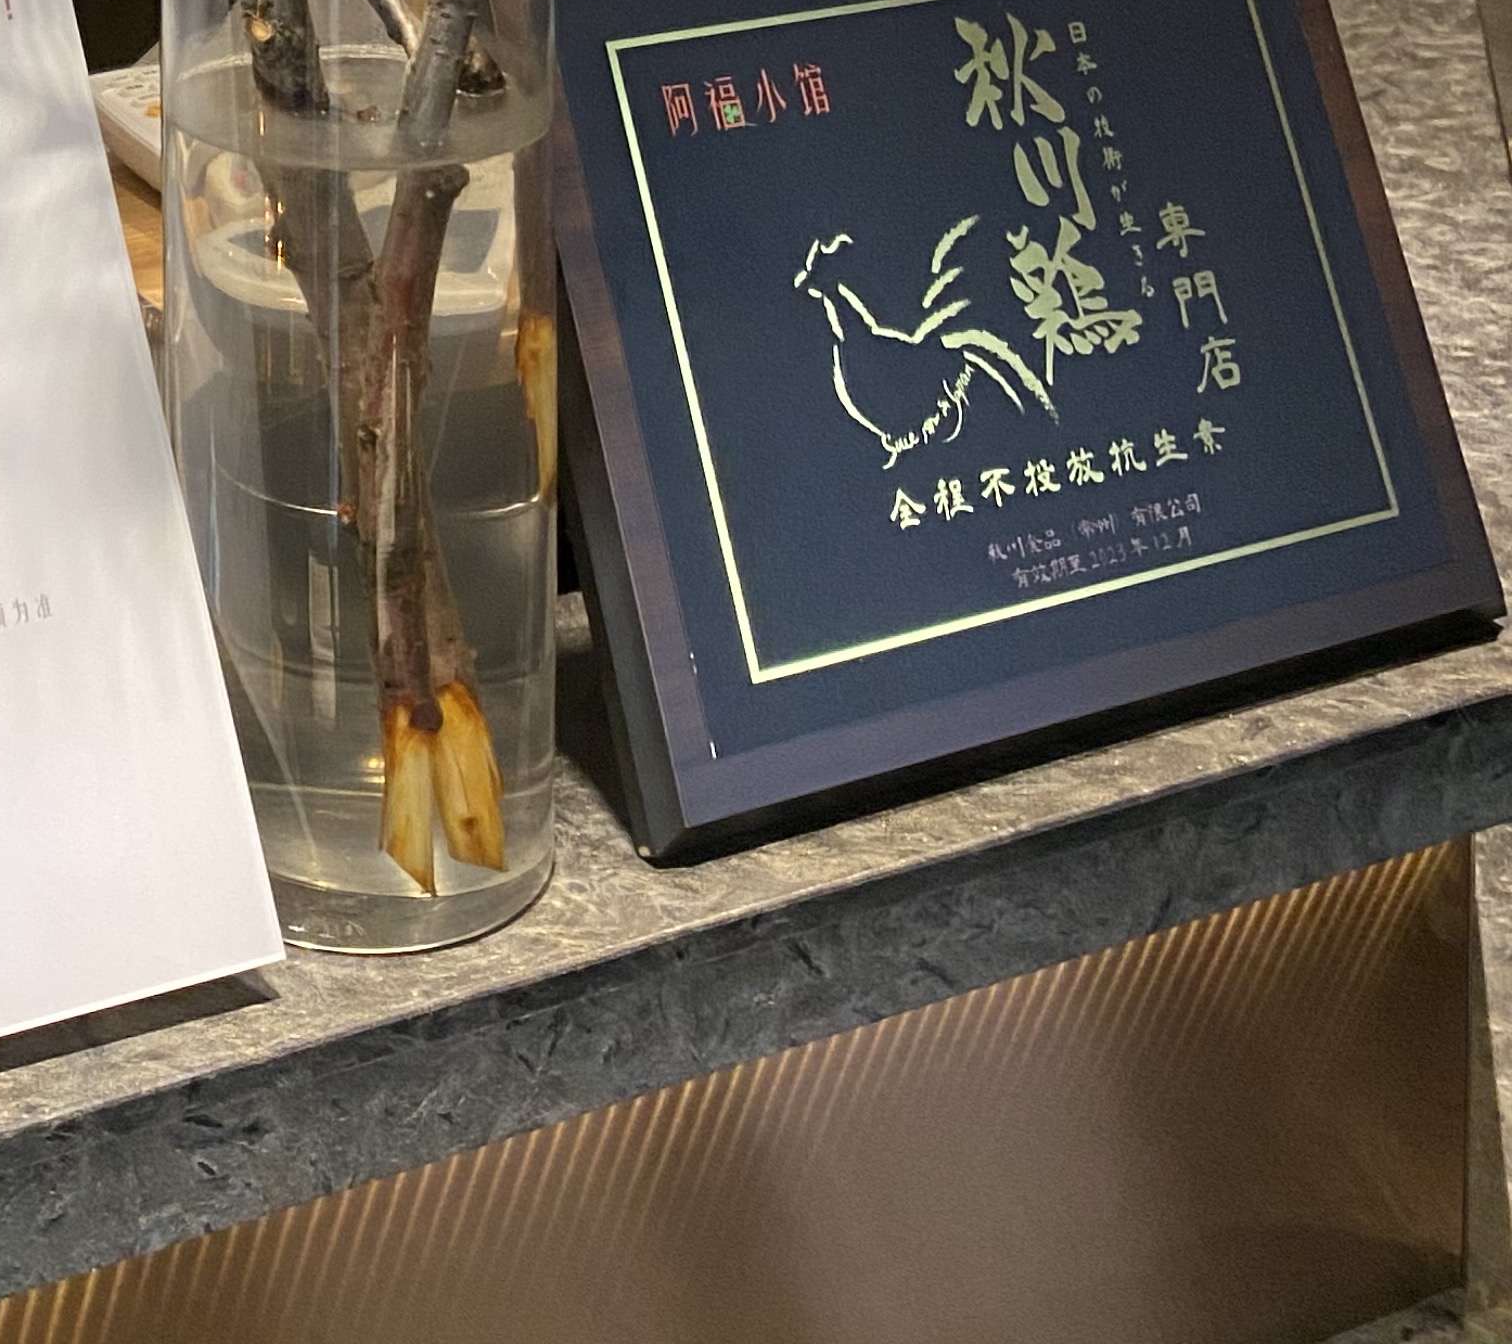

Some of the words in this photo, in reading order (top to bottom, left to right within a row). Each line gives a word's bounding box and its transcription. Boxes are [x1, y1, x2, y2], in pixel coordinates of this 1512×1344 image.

[662, 62, 831, 136] 阿福小馆
[890, 417, 1226, 530] 全程不投放抗生素
